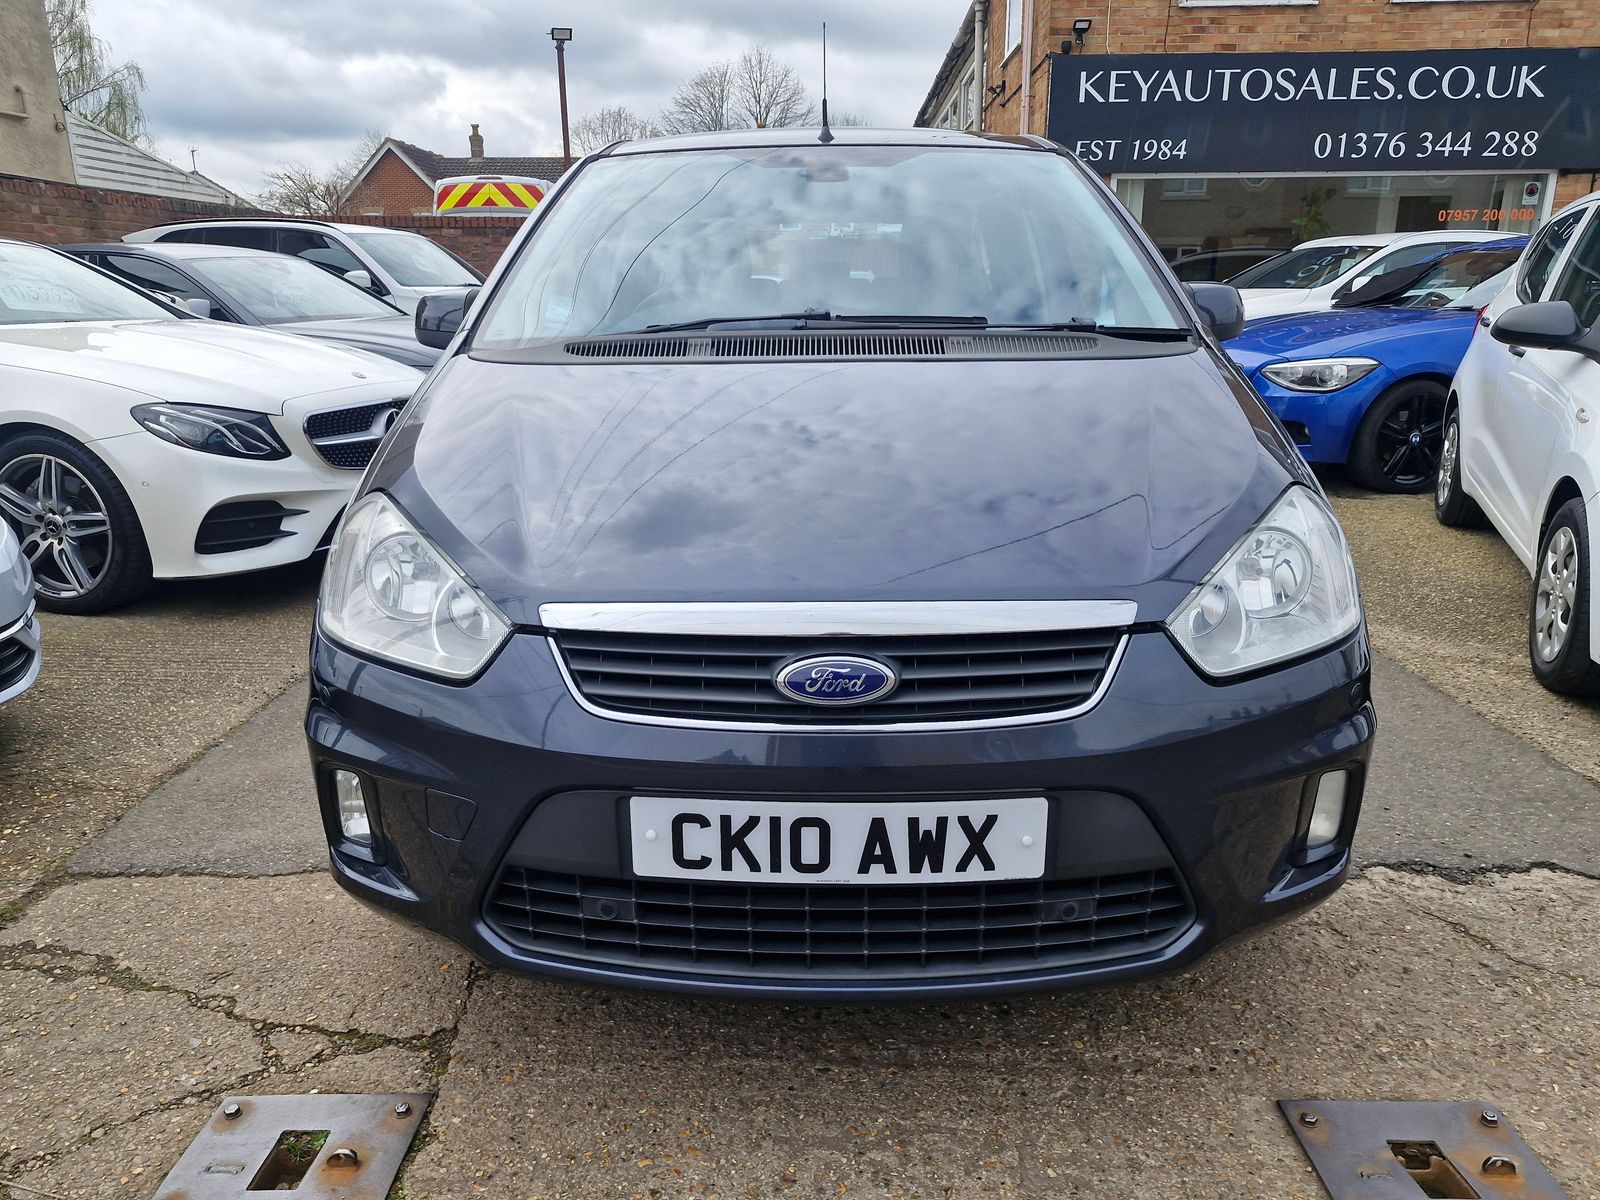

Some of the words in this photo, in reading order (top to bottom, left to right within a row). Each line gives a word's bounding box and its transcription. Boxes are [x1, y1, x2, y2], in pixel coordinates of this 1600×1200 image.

[1078, 65, 1547, 103] KEYAUTOSALES.CO.UK
[1075, 139, 1122, 162] EST
[1133, 138, 1187, 161] 1984
[1314, 131, 1407, 159] 01376
[1416, 131, 1472, 158] 344
[1481, 130, 1539, 157] 288
[1438, 209, 1479, 222] 07957
[1482, 208, 1506, 222] 200
[1510, 208, 1535, 221] 000
[805, 667, 865, 693] Ford
[671, 812, 831, 874] CK10
[857, 814, 999, 875] AWX
